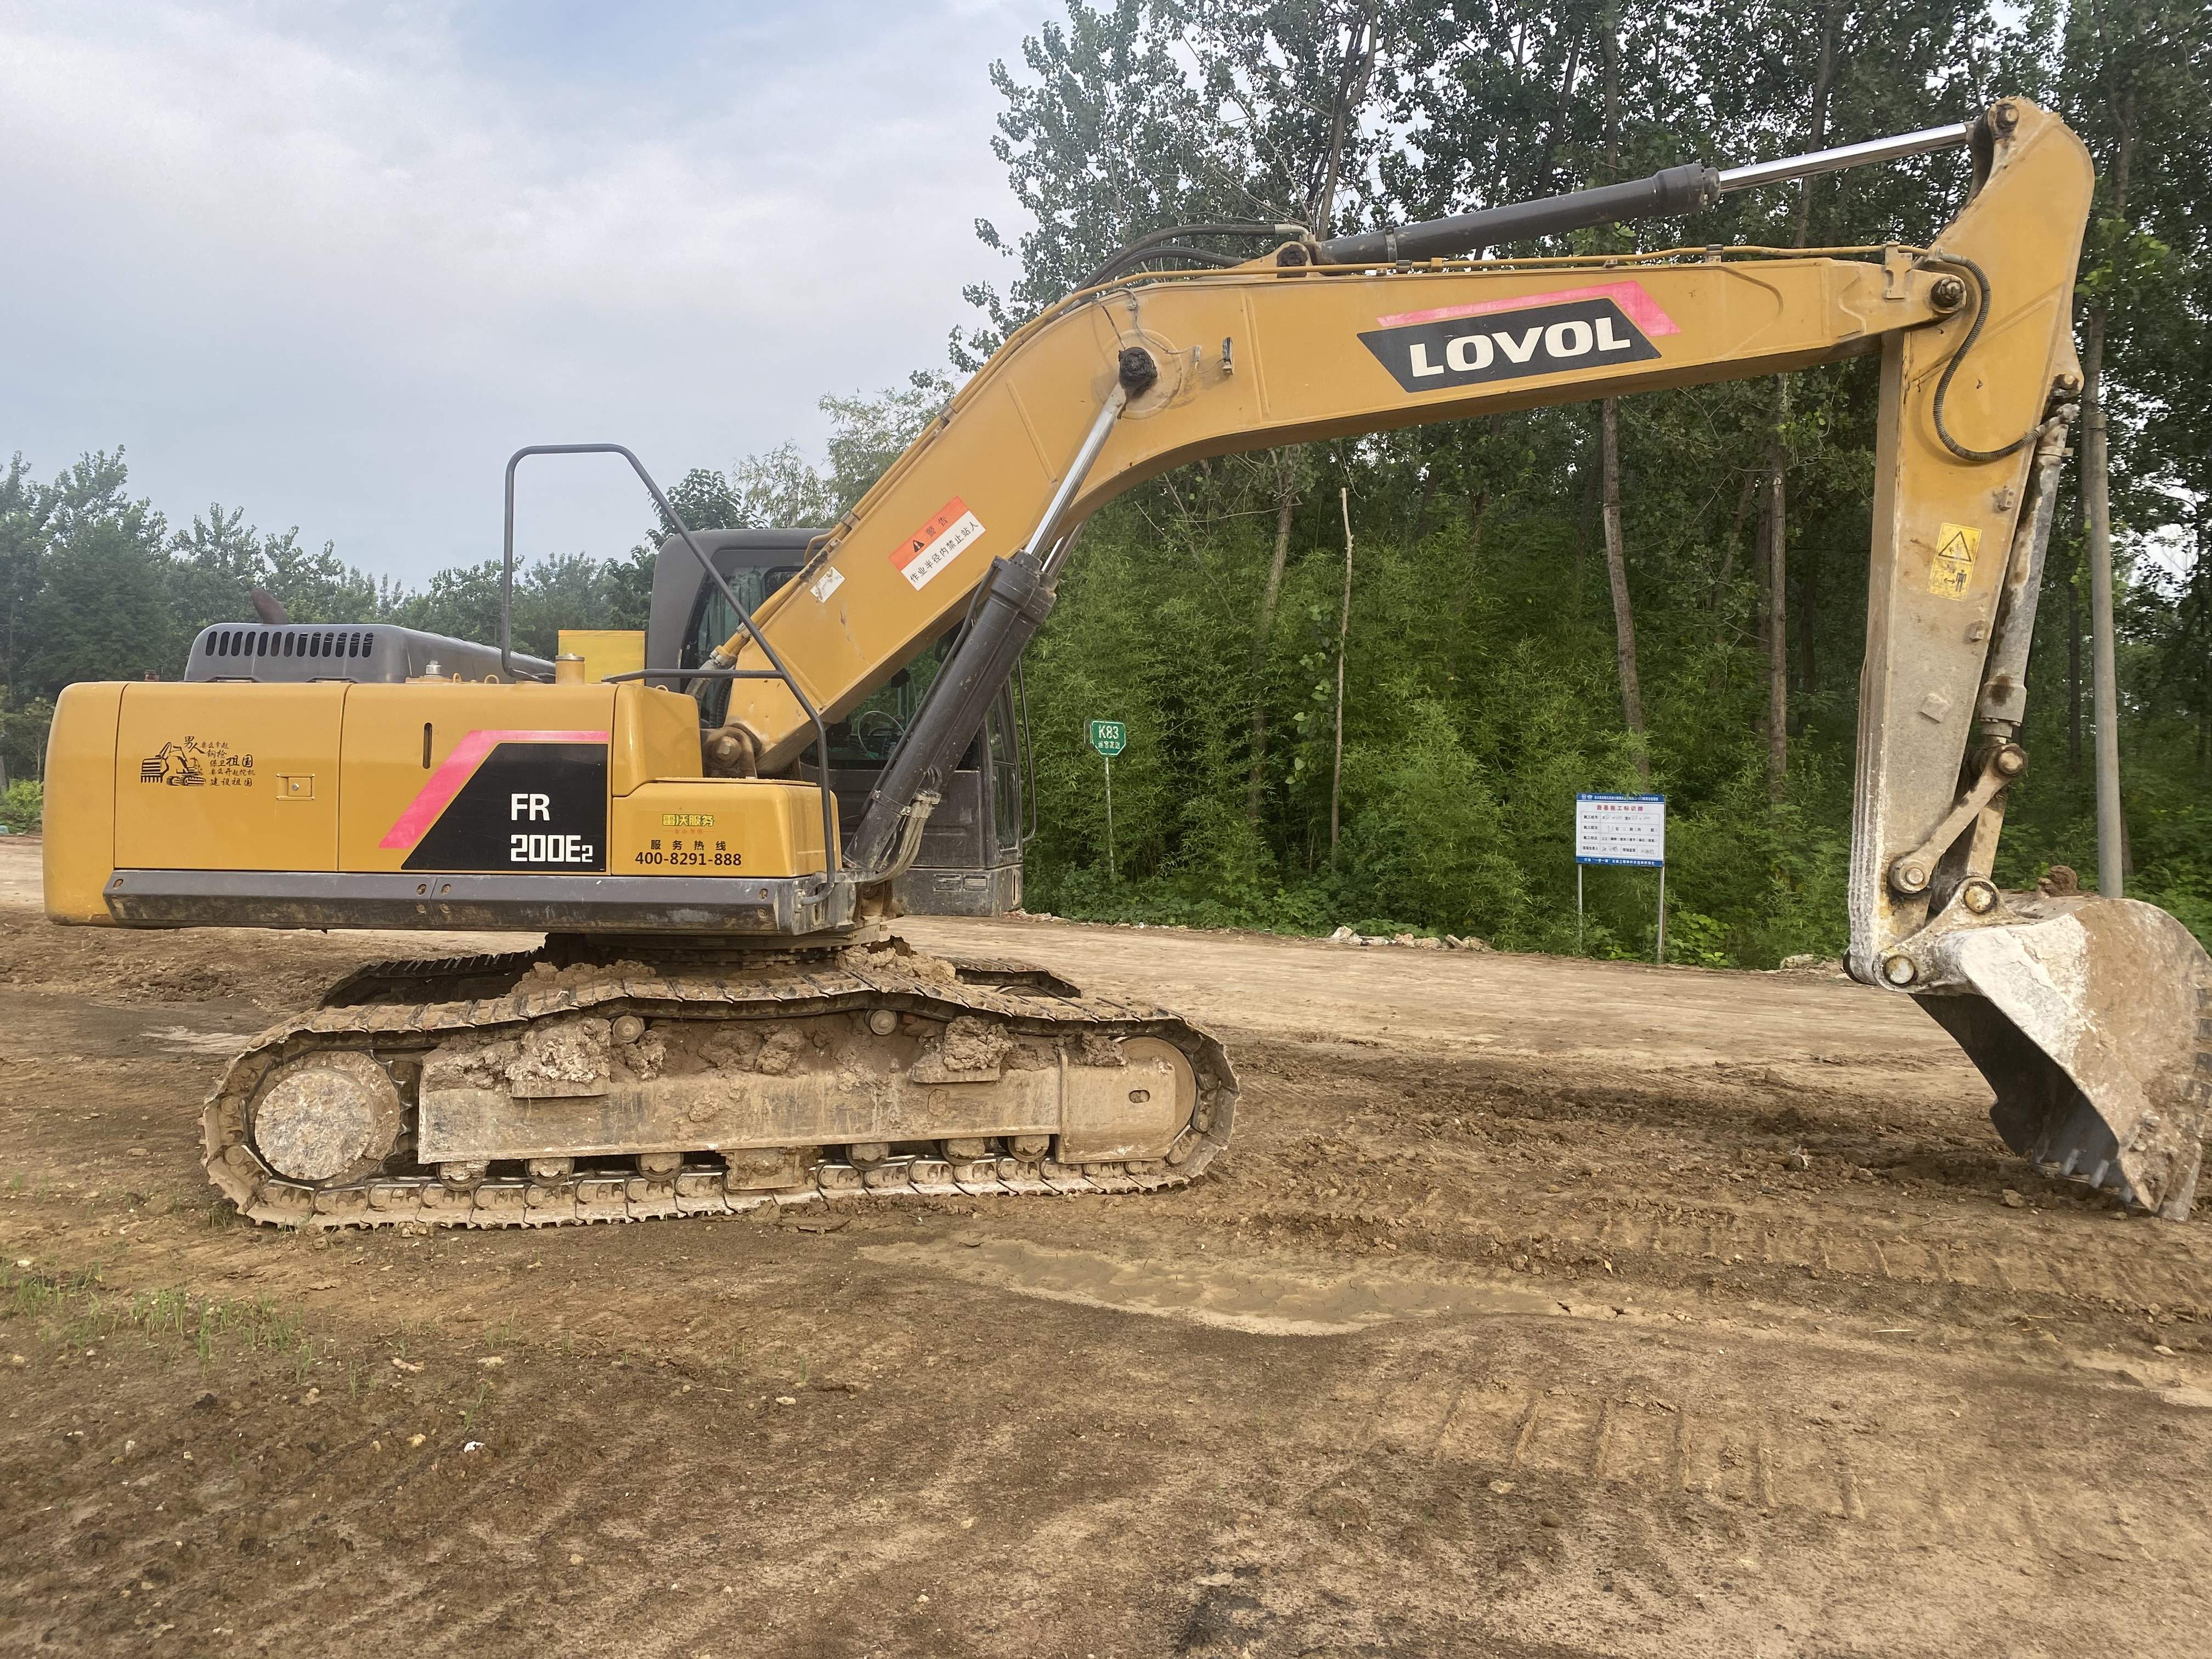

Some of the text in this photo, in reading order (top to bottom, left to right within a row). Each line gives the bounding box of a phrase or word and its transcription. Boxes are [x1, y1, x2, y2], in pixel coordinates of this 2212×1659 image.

[1409, 317, 1631, 377] LOVOL
[925, 516, 949, 538] 警告
[910, 521, 979, 583] 作业半径内禁止站人
[1098, 724, 1119, 740] K83
[184, 735, 206, 754] 男人
[210, 754, 253, 768] 保卫祖国
[210, 776, 252, 787] 建设祖国
[511, 793, 550, 821] FR
[662, 814, 715, 827] 雷沃服务
[511, 834, 593, 862] 200E2
[651, 839, 726, 851] 服务热线
[635, 851, 742, 866] 400-8291-888
